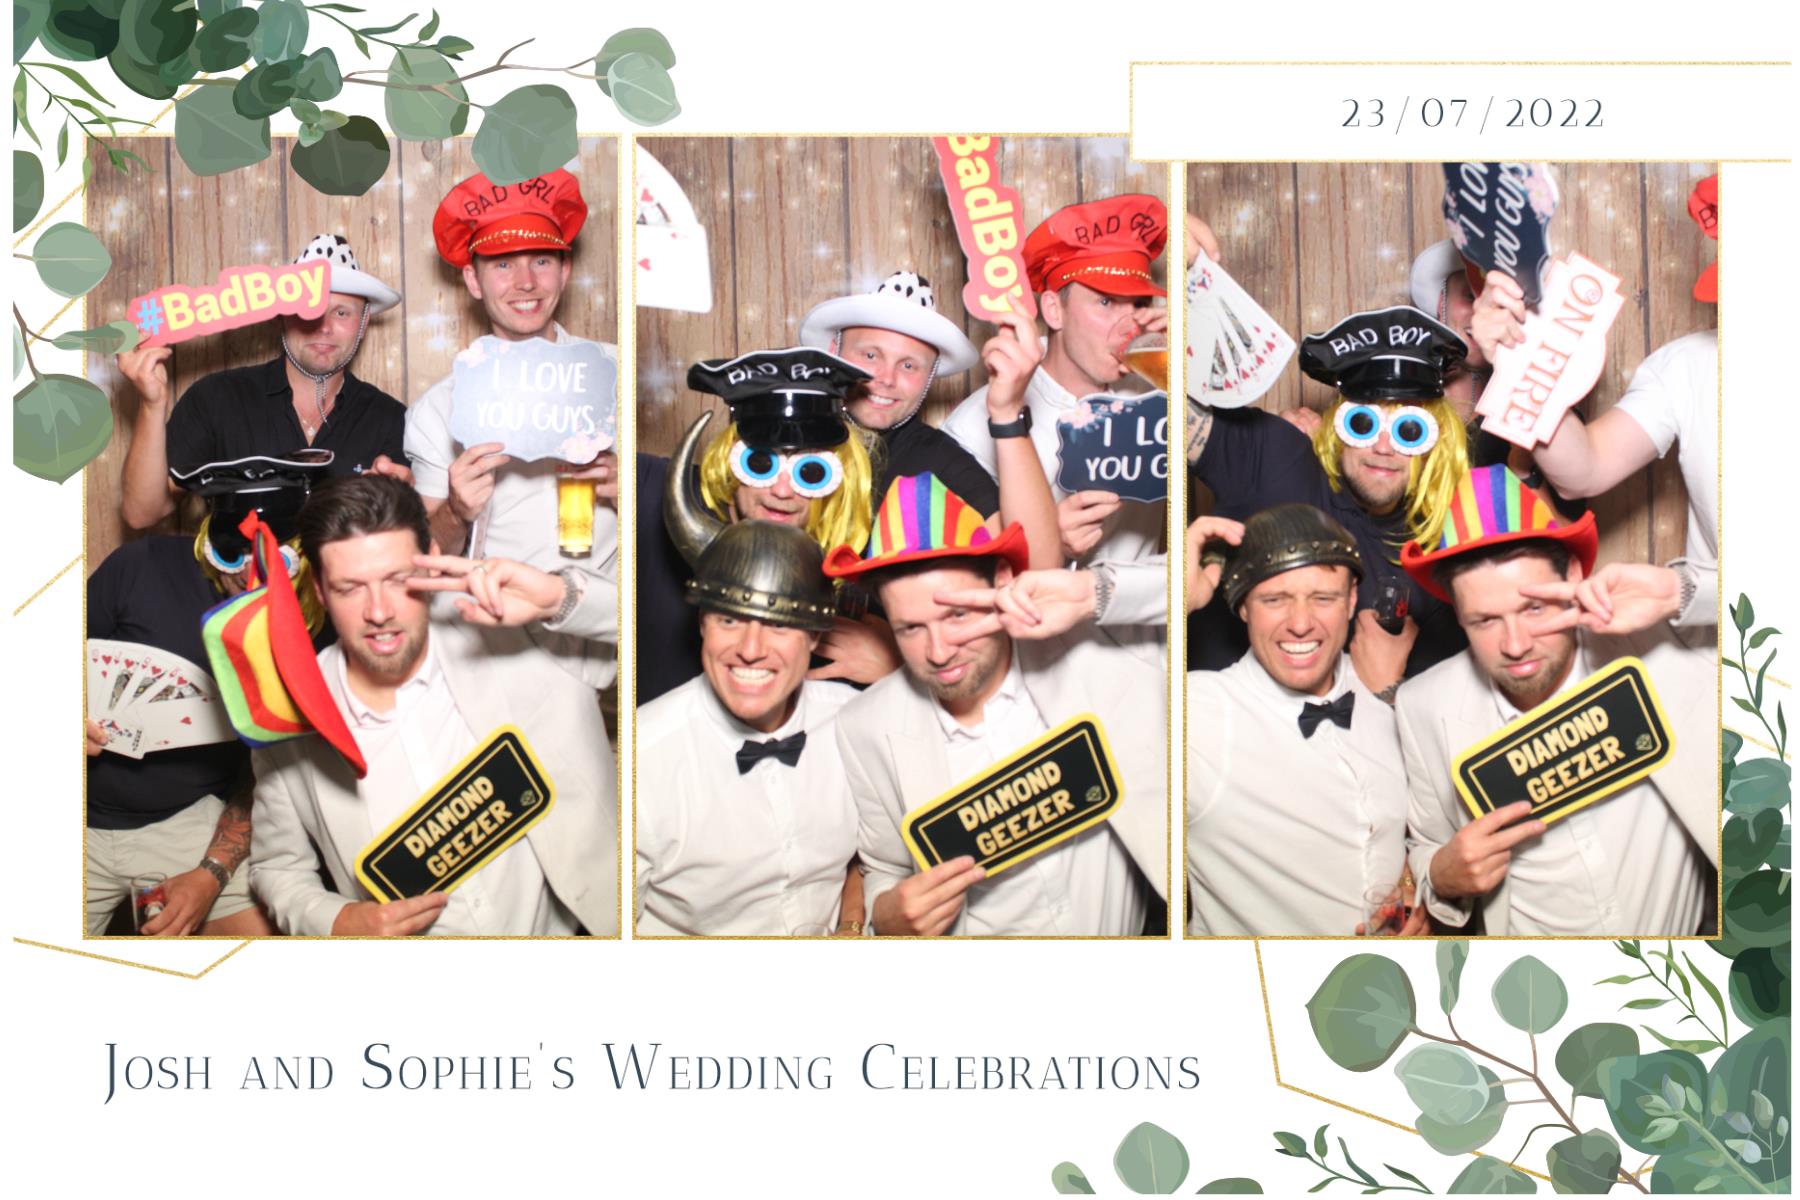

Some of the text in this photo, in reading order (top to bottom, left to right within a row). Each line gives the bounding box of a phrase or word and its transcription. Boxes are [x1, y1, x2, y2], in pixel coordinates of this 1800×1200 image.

[464, 184, 508, 217] BAD
[1075, 214, 1121, 246] BAD
[1494, 220, 1521, 277] YOU
[136, 265, 325, 336] #BadBoy
[1329, 324, 1432, 357] BAD BOY
[1502, 273, 1604, 433] ON FIRE
[492, 358, 588, 394] I LOVE
[476, 401, 595, 435] YOU GUYS
[1103, 416, 1113, 448] I
[1085, 455, 1142, 482] YOU
[1505, 705, 1609, 777] DIAMOND
[1526, 736, 1626, 804] GEEZER
[403, 776, 494, 859] DIAMOND
[957, 760, 1062, 832] DIAMOND
[975, 789, 1076, 857] GEEZER
[426, 799, 513, 878] GEEZER
